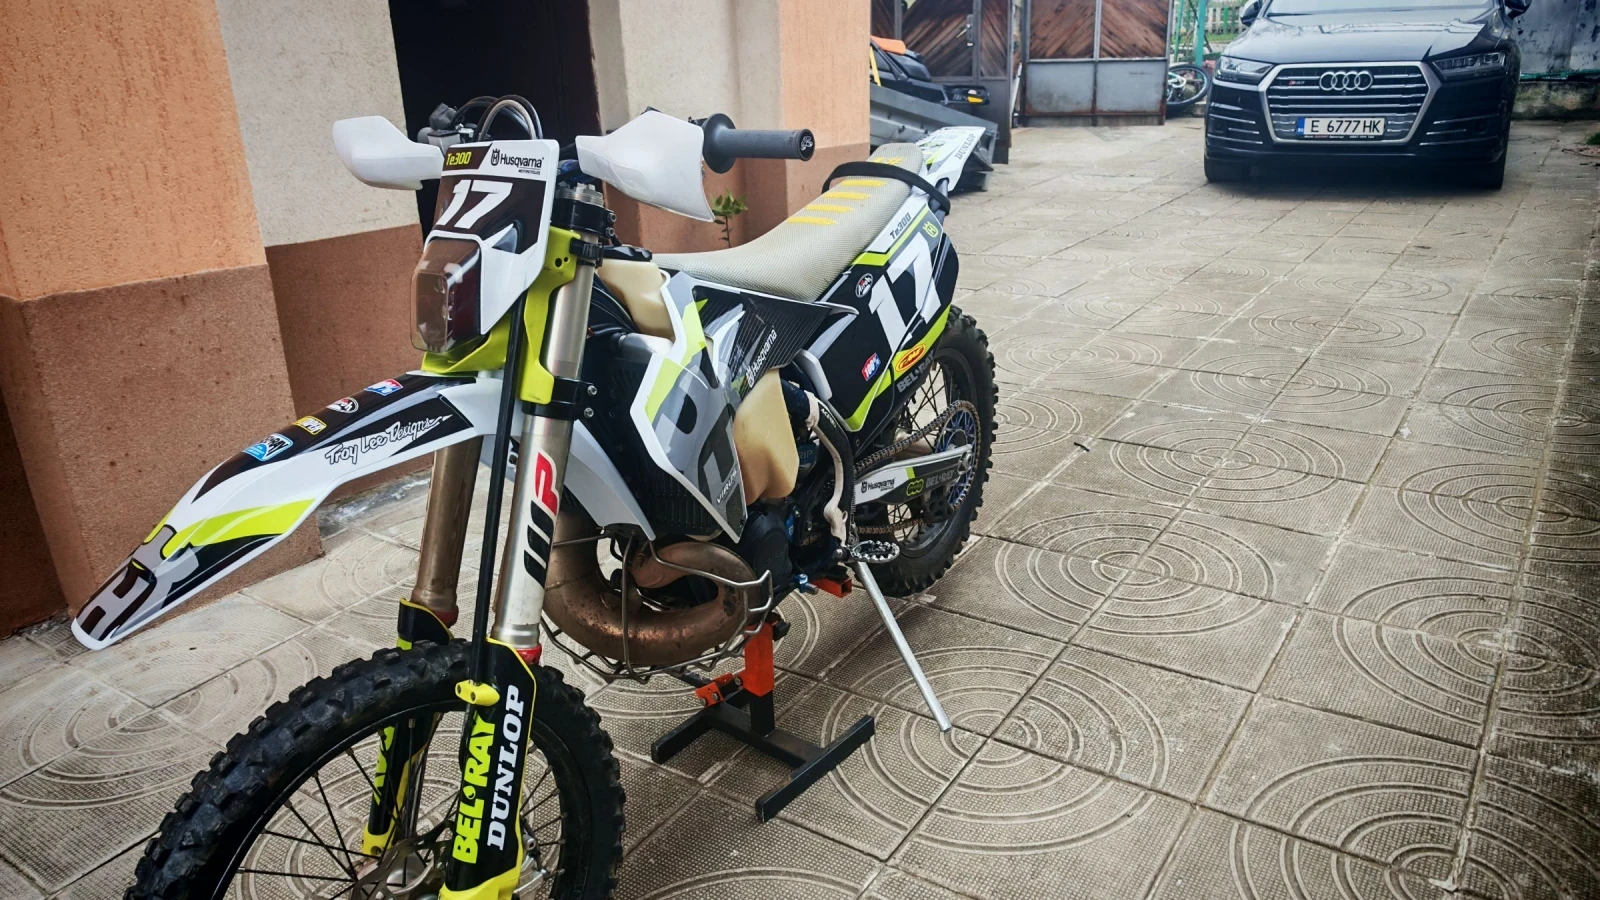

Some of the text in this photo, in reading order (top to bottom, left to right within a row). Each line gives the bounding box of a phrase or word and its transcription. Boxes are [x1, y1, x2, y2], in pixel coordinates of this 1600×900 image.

[1311, 119, 1381, 133] E 6777 HK
[445, 151, 472, 166] Te300
[500, 153, 543, 168] Husqvarna
[955, 133, 976, 160] DUNLOP
[435, 179, 513, 229] 17
[889, 212, 912, 240] Te300
[868, 232, 942, 354] 17
[752, 328, 778, 377] Husqvarna
[325, 415, 447, 465] Troy Lee Designs
[868, 478, 895, 491] Husqvarna
[487, 684, 525, 850] DUNLOP
